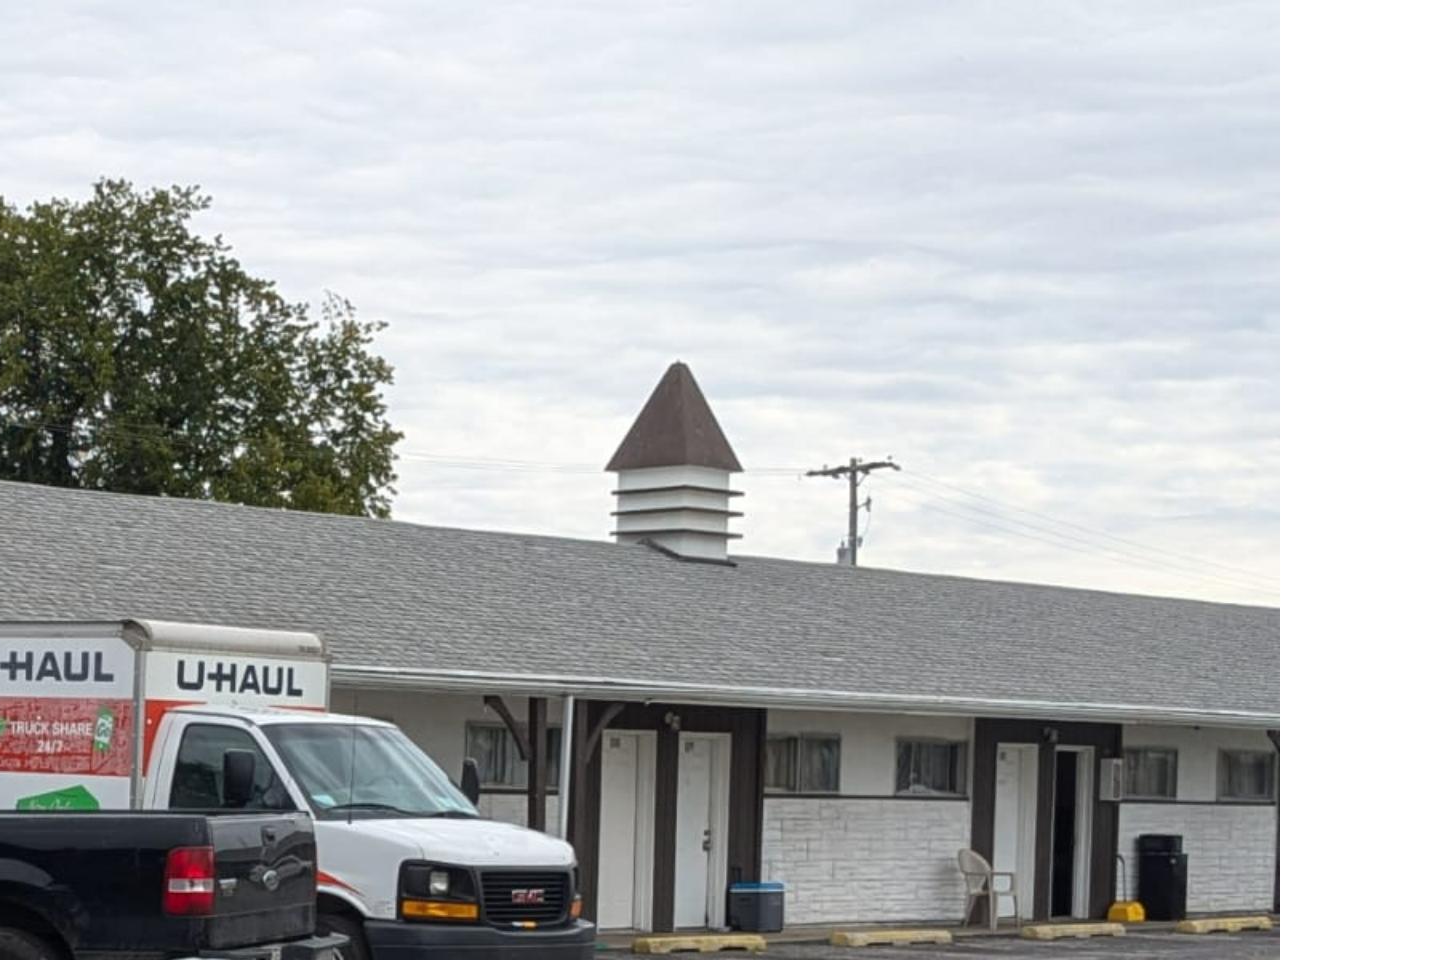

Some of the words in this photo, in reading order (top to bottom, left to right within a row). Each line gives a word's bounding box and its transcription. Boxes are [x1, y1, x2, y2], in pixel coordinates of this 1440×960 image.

[177, 659, 303, 697] U-HAUL
[11, 720, 49, 735] TRUCK
[52, 720, 93, 735] SHARE
[36, 739, 63, 753] 24/7
[511, 889, 544, 904] GMC
